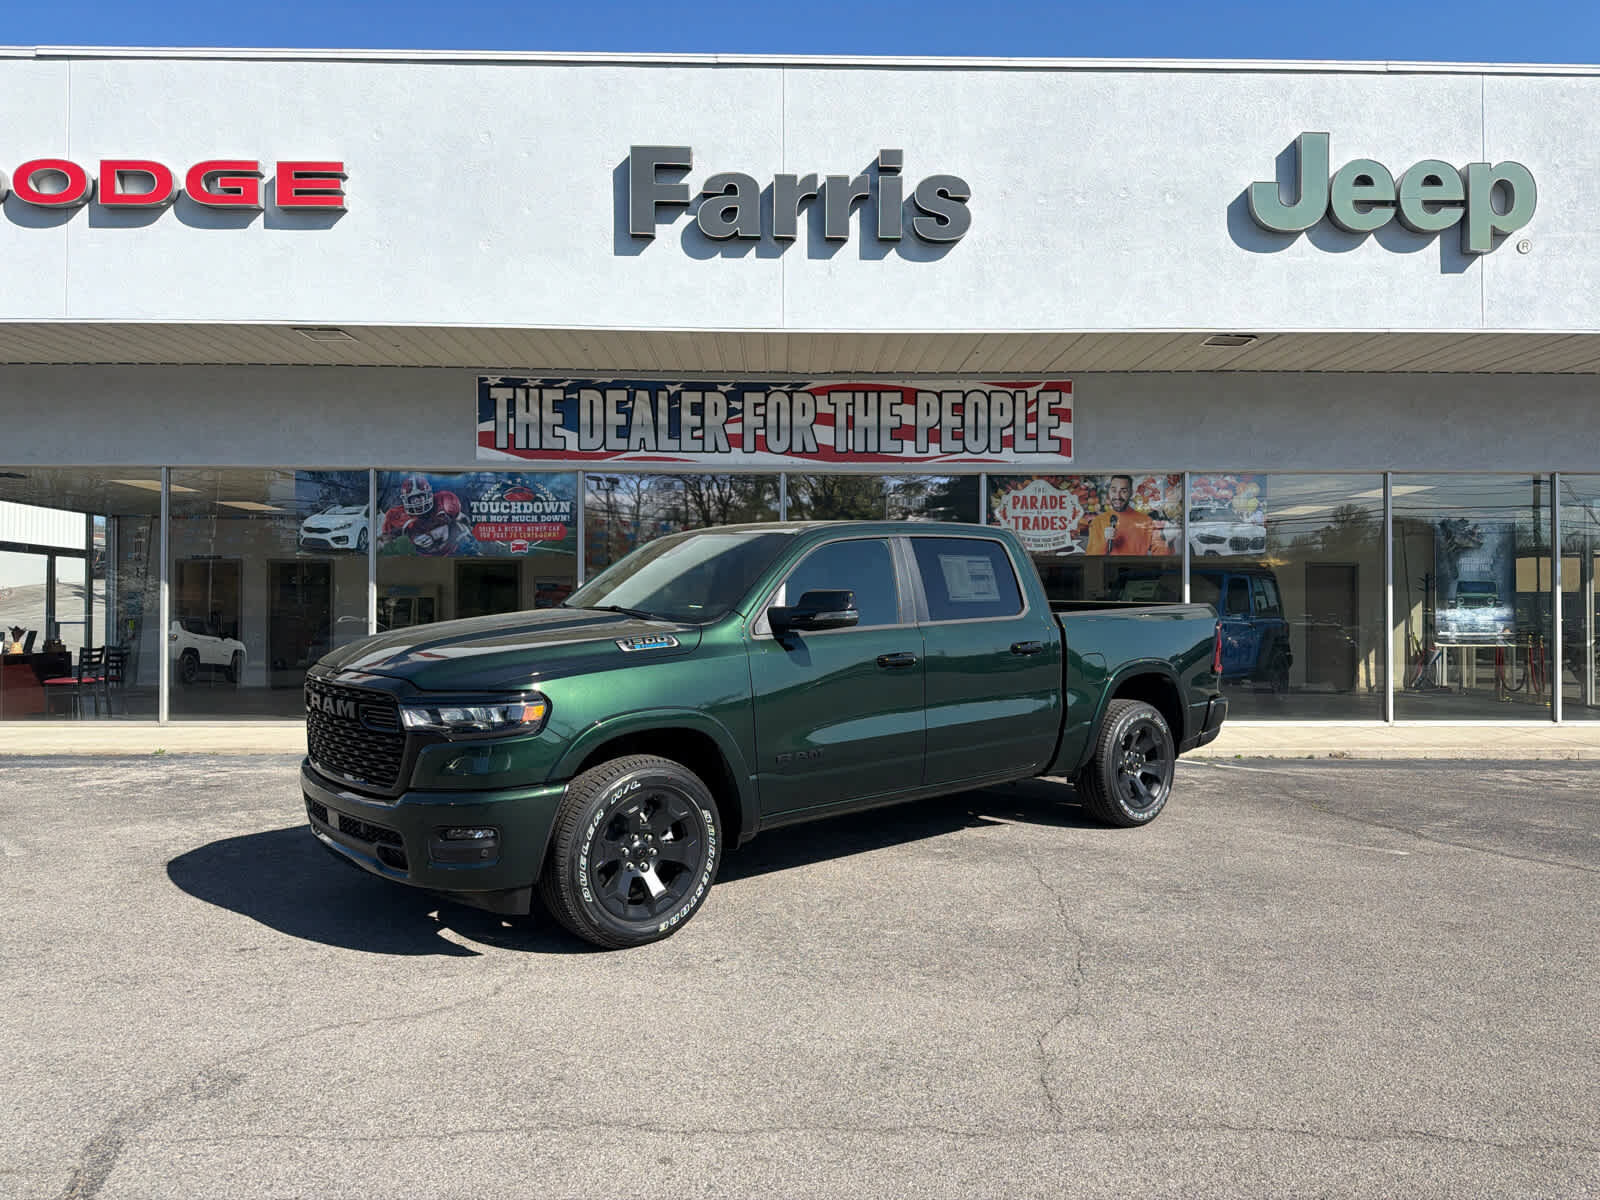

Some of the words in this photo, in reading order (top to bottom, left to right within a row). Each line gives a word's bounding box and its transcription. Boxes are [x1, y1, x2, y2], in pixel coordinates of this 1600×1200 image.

[0, 158, 348, 212] ODGE
[630, 145, 973, 241] Farris
[1251, 131, 1538, 252] Jeep
[489, 386, 566, 450] THE
[577, 388, 732, 453] DEALER
[741, 389, 820, 454] FOR
[828, 390, 904, 454] THE
[915, 390, 1062, 454] PEOPLE
[470, 501, 571, 513] TOUCHDOWN
[1012, 495, 1067, 510] PARADE
[471, 514, 487, 522] FOR
[490, 514, 508, 522] NOT
[511, 514, 537, 522] MUCH
[540, 514, 570, 522] DOWN!
[1012, 516, 1067, 530] TRADES
[312, 693, 355, 719] RAM
